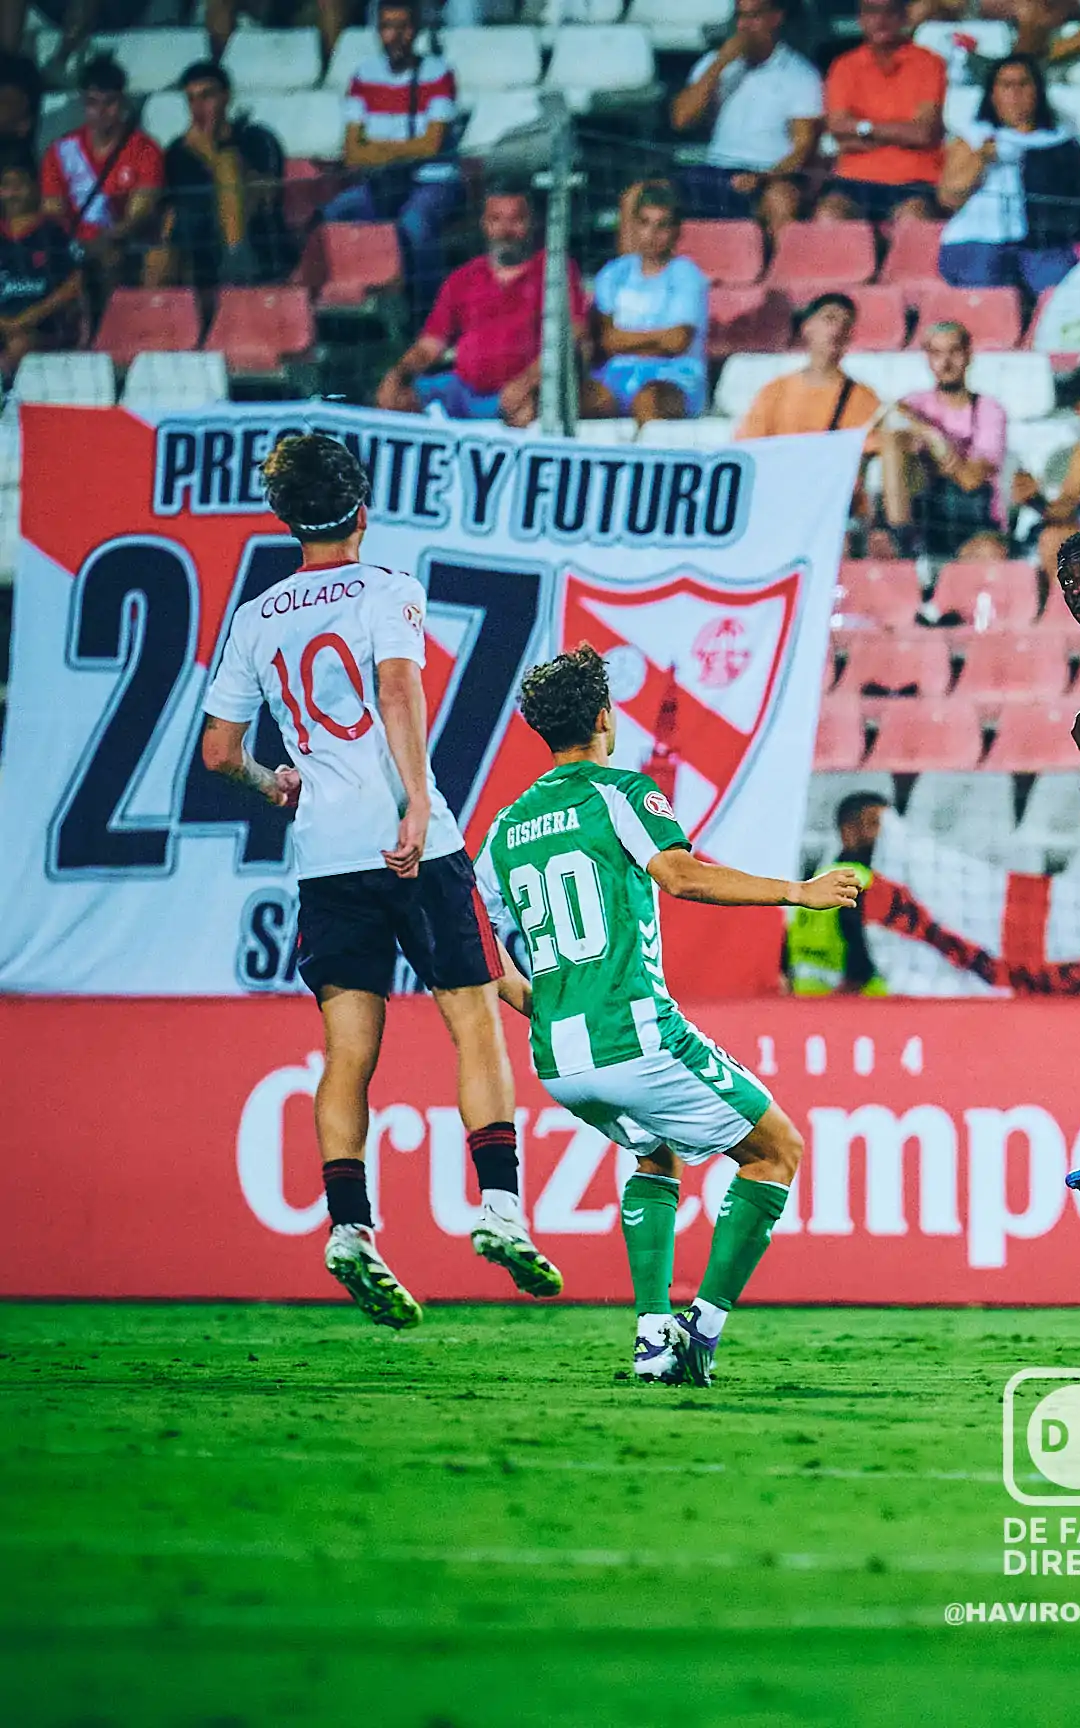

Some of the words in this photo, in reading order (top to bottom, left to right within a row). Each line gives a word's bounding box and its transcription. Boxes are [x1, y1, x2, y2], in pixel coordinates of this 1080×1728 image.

[162, 426, 444, 519] PRENTE
[471, 447, 506, 526] Y
[522, 456, 742, 537] FUTURO
[260, 579, 365, 619] COLLADO
[270, 632, 374, 756] 10
[506, 807, 581, 850] GISMERA
[508, 849, 609, 977] 20
